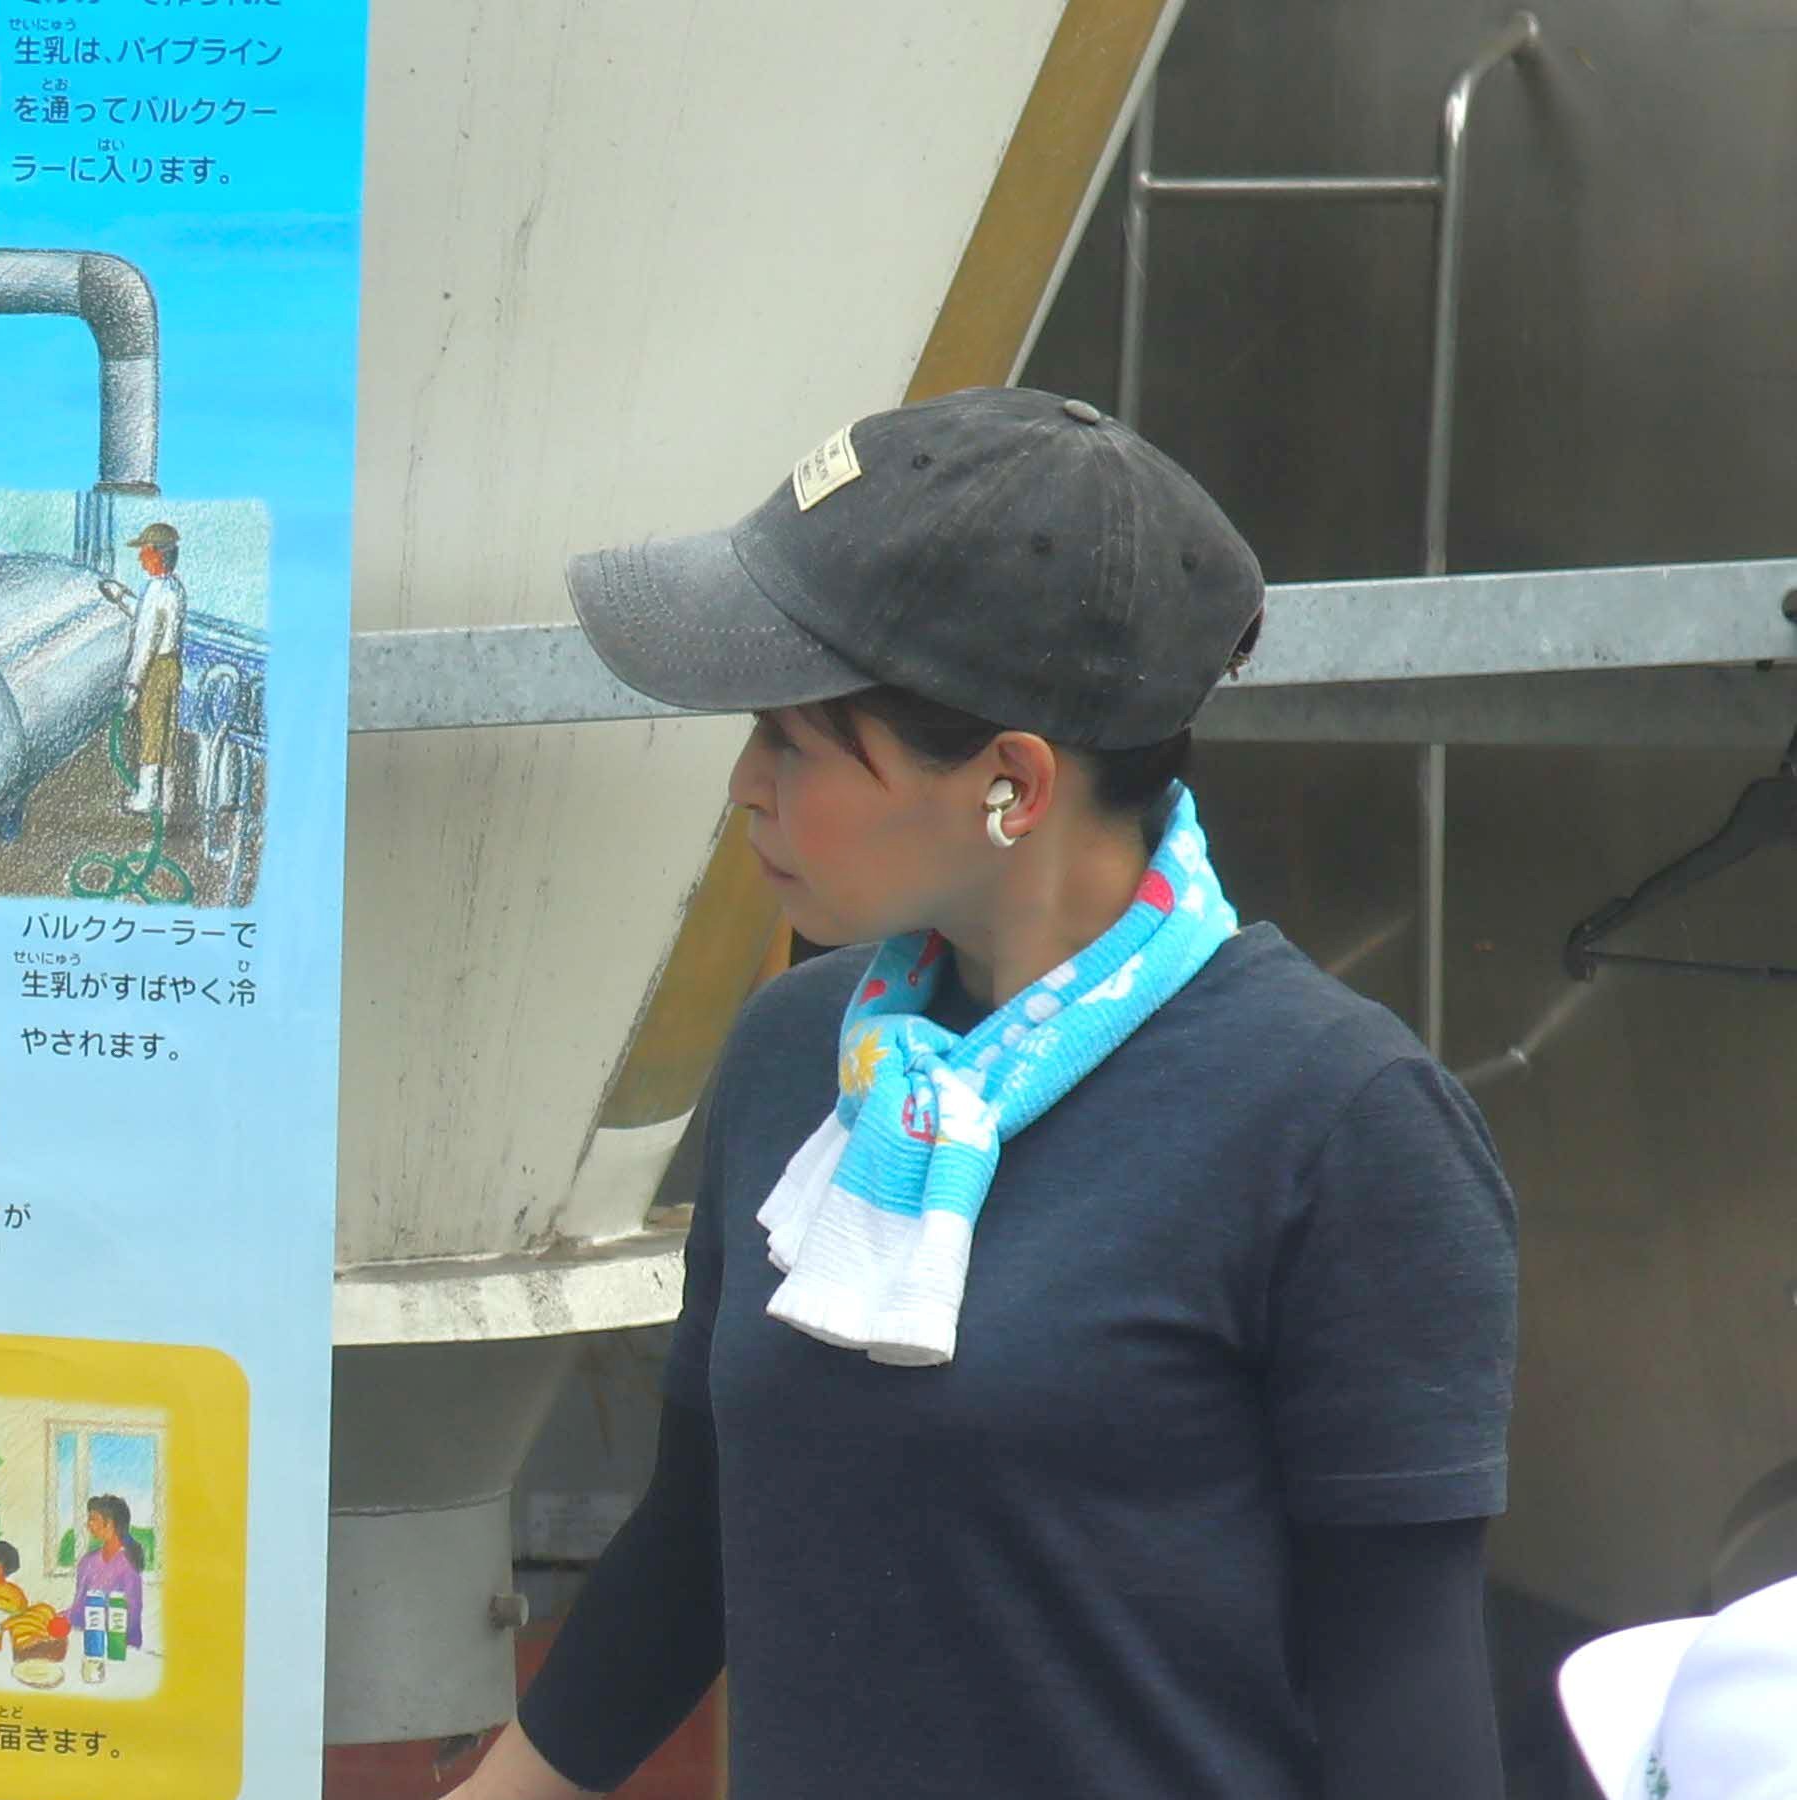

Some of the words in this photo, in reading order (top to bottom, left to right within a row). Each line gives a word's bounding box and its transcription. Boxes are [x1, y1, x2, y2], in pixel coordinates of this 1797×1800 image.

[42, 78, 68, 91] とお
[14, 95, 278, 125] を通ってバルククー
[97, 138, 125, 151] はい
[12, 155, 230, 184] ラーに入ります。
[22, 912, 257, 948] バルククーラーで
[21, 969, 257, 1007] 生乳がすばやく冷
[20, 1027, 179, 1061] やされます。
